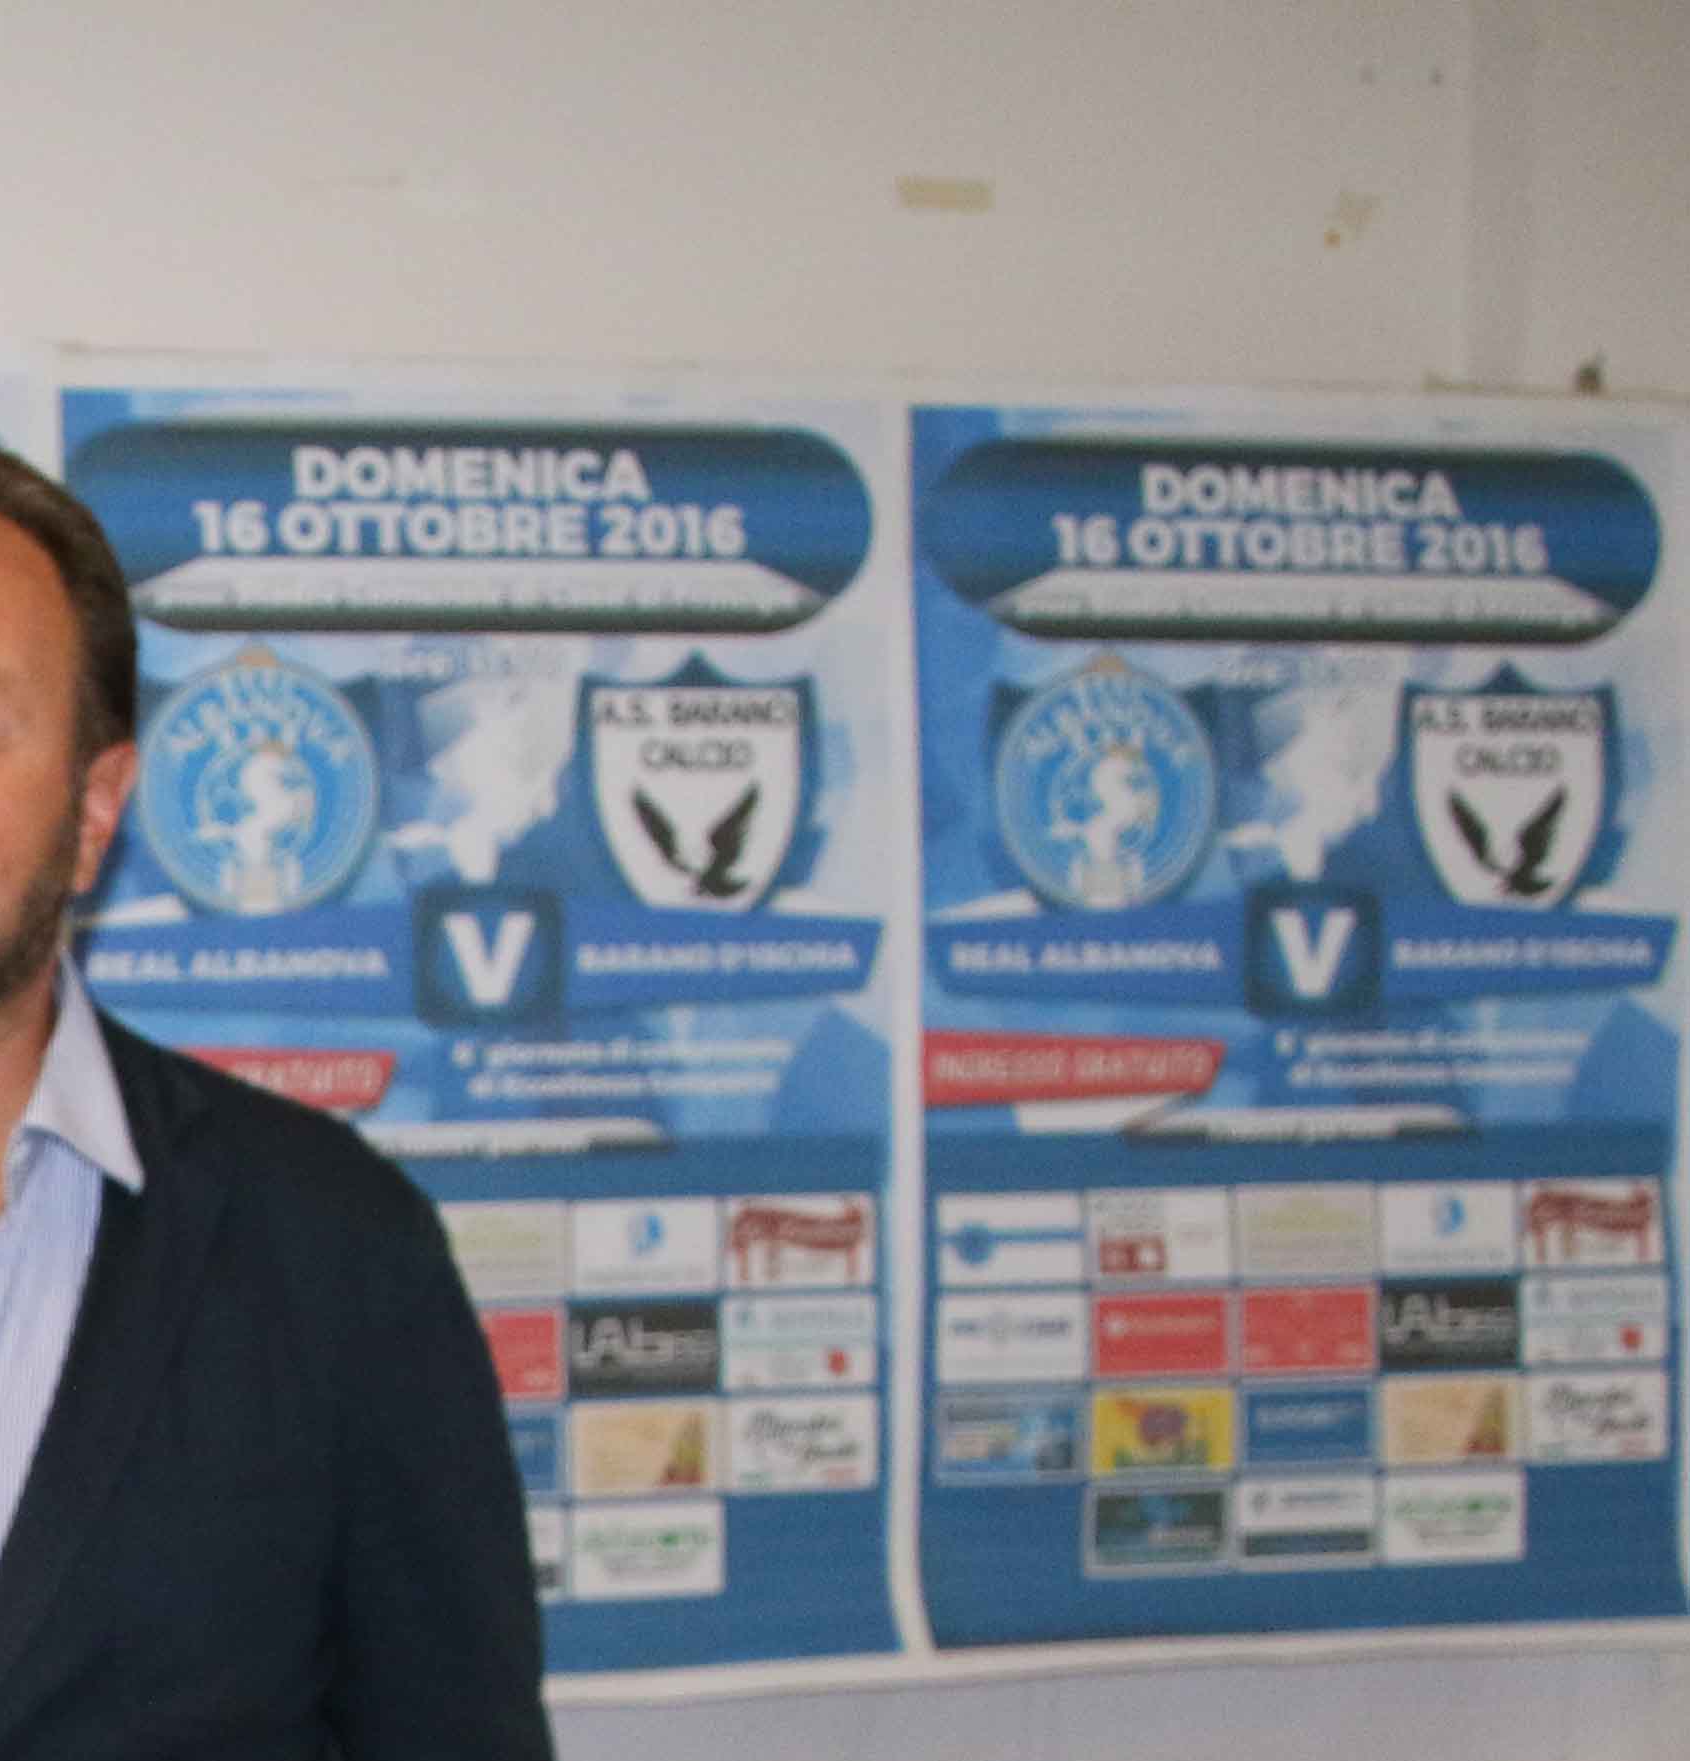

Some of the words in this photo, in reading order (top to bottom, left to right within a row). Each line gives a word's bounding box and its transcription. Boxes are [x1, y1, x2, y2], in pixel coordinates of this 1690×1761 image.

[291, 448, 651, 499] DOMENICA
[1140, 463, 1463, 519] DOMENICA
[193, 500, 270, 557] 16
[278, 502, 588, 557] OTTOBRE
[599, 504, 746, 558] 2016
[1051, 513, 1118, 564] 16
[1128, 517, 1405, 571] OTTOBRE
[1413, 523, 1550, 574] 2016
[642, 738, 754, 772] CALCIO
[441, 912, 536, 1006] V
[1270, 907, 1357, 998] V
